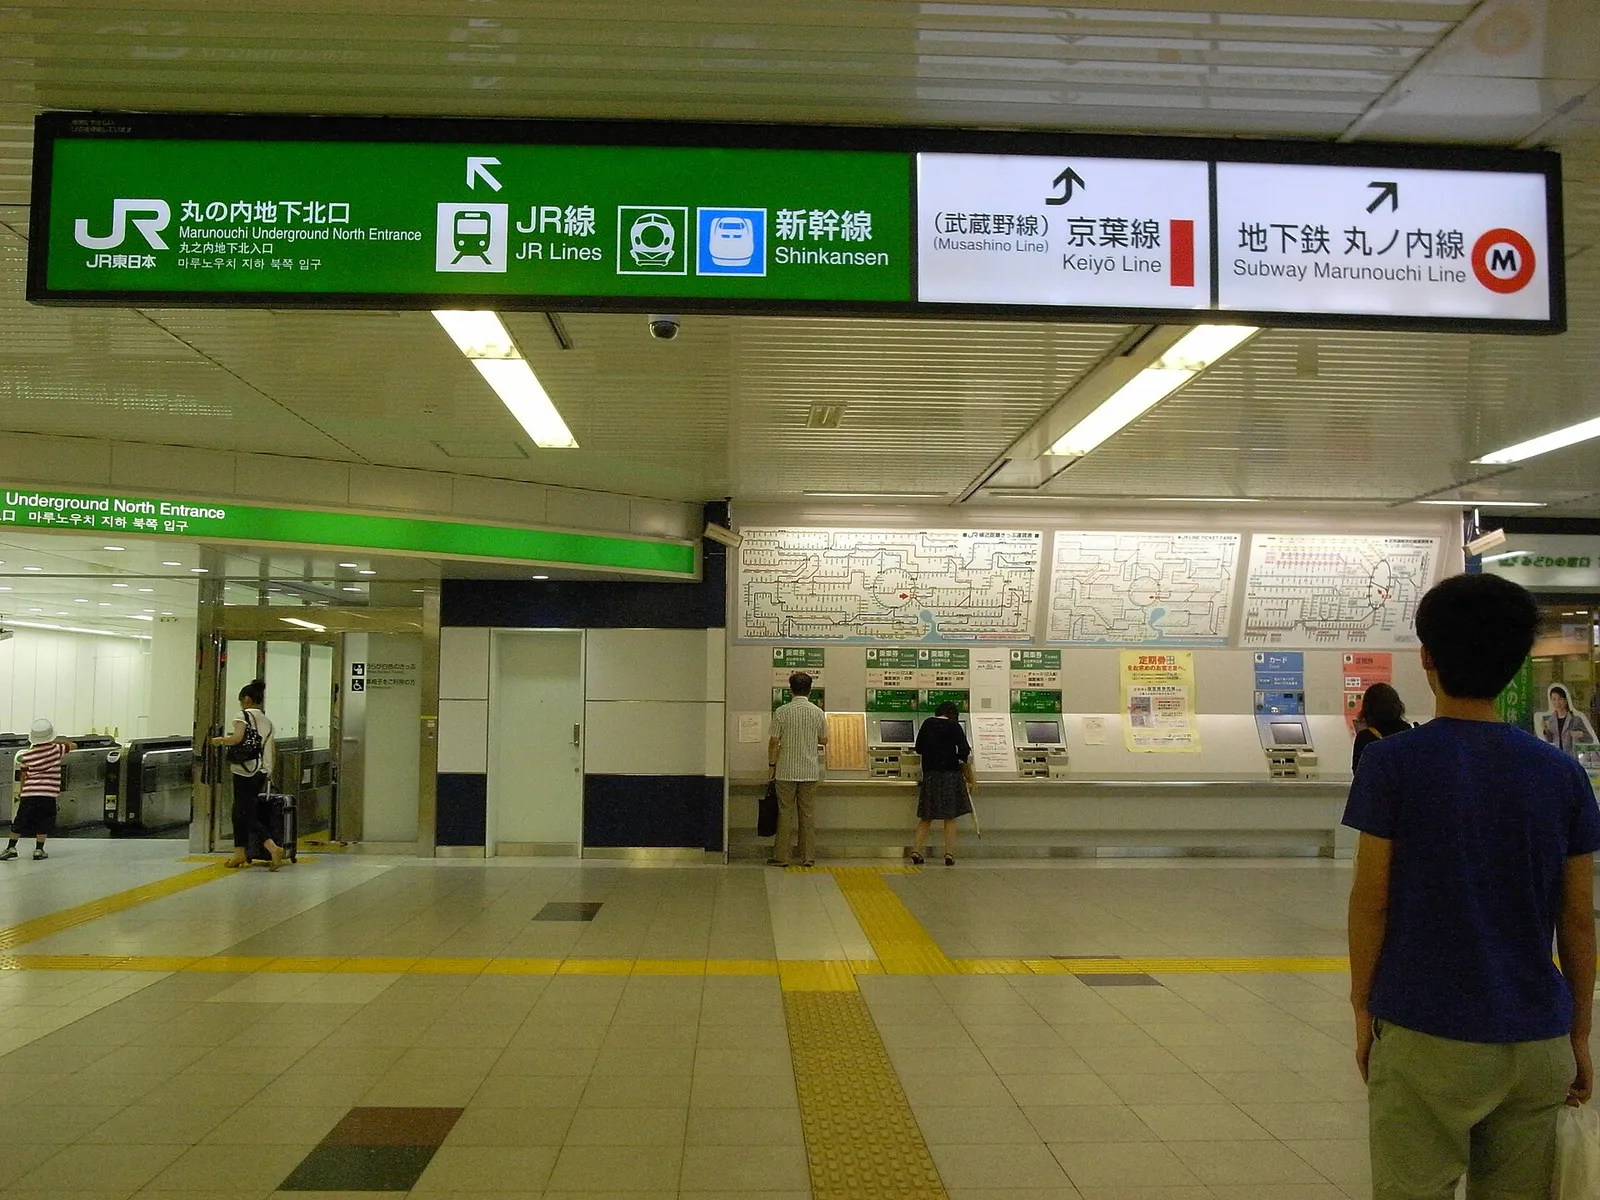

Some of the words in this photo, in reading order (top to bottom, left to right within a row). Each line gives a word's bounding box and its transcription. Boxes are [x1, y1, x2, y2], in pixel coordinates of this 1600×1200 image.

[180, 200, 350, 224] 丸の内地下北口
[516, 205, 596, 237] JR線
[75, 199, 171, 250] JR
[179, 226, 249, 240] Marunouchi
[252, 227, 329, 243] Underground
[332, 228, 365, 241] North
[369, 228, 422, 242] Entrance
[776, 209, 873, 242] 新幹線
[1067, 217, 1161, 250] 京葉線
[179, 242, 273, 255] 丸之内地下北入口
[516, 243, 543, 260] JR
[549, 243, 602, 261] Lines
[933, 237, 1012, 252] (Musashino
[1016, 240, 1049, 253] Line)
[1237, 221, 1331, 257] 地下鉄
[1343, 225, 1465, 260] 丸ノ内線
[86, 254, 156, 269] JR東日本
[177, 258, 237, 270] 마루노우치
[242, 259, 265, 270] 지하
[270, 259, 294, 271] 북쪽
[298, 259, 322, 271] 입구
[775, 247, 889, 266] Shinkansen
[1063, 254, 1116, 274] Keiyō
[1122, 256, 1162, 273] Line
[1491, 249, 1518, 272] M
[1233, 259, 1307, 281] Subway
[1314, 262, 1422, 281] Marunouchi
[1428, 266, 1466, 283] Line
[5, 491, 109, 511] Underground
[114, 498, 156, 515] North
[160, 502, 226, 520] Entrance
[0, 510, 16, 522] 口
[28, 511, 95, 527] 마루노우치
[102, 515, 128, 529] 지하
[132, 518, 158, 531] 북쪽
[163, 520, 189, 533] 입구
